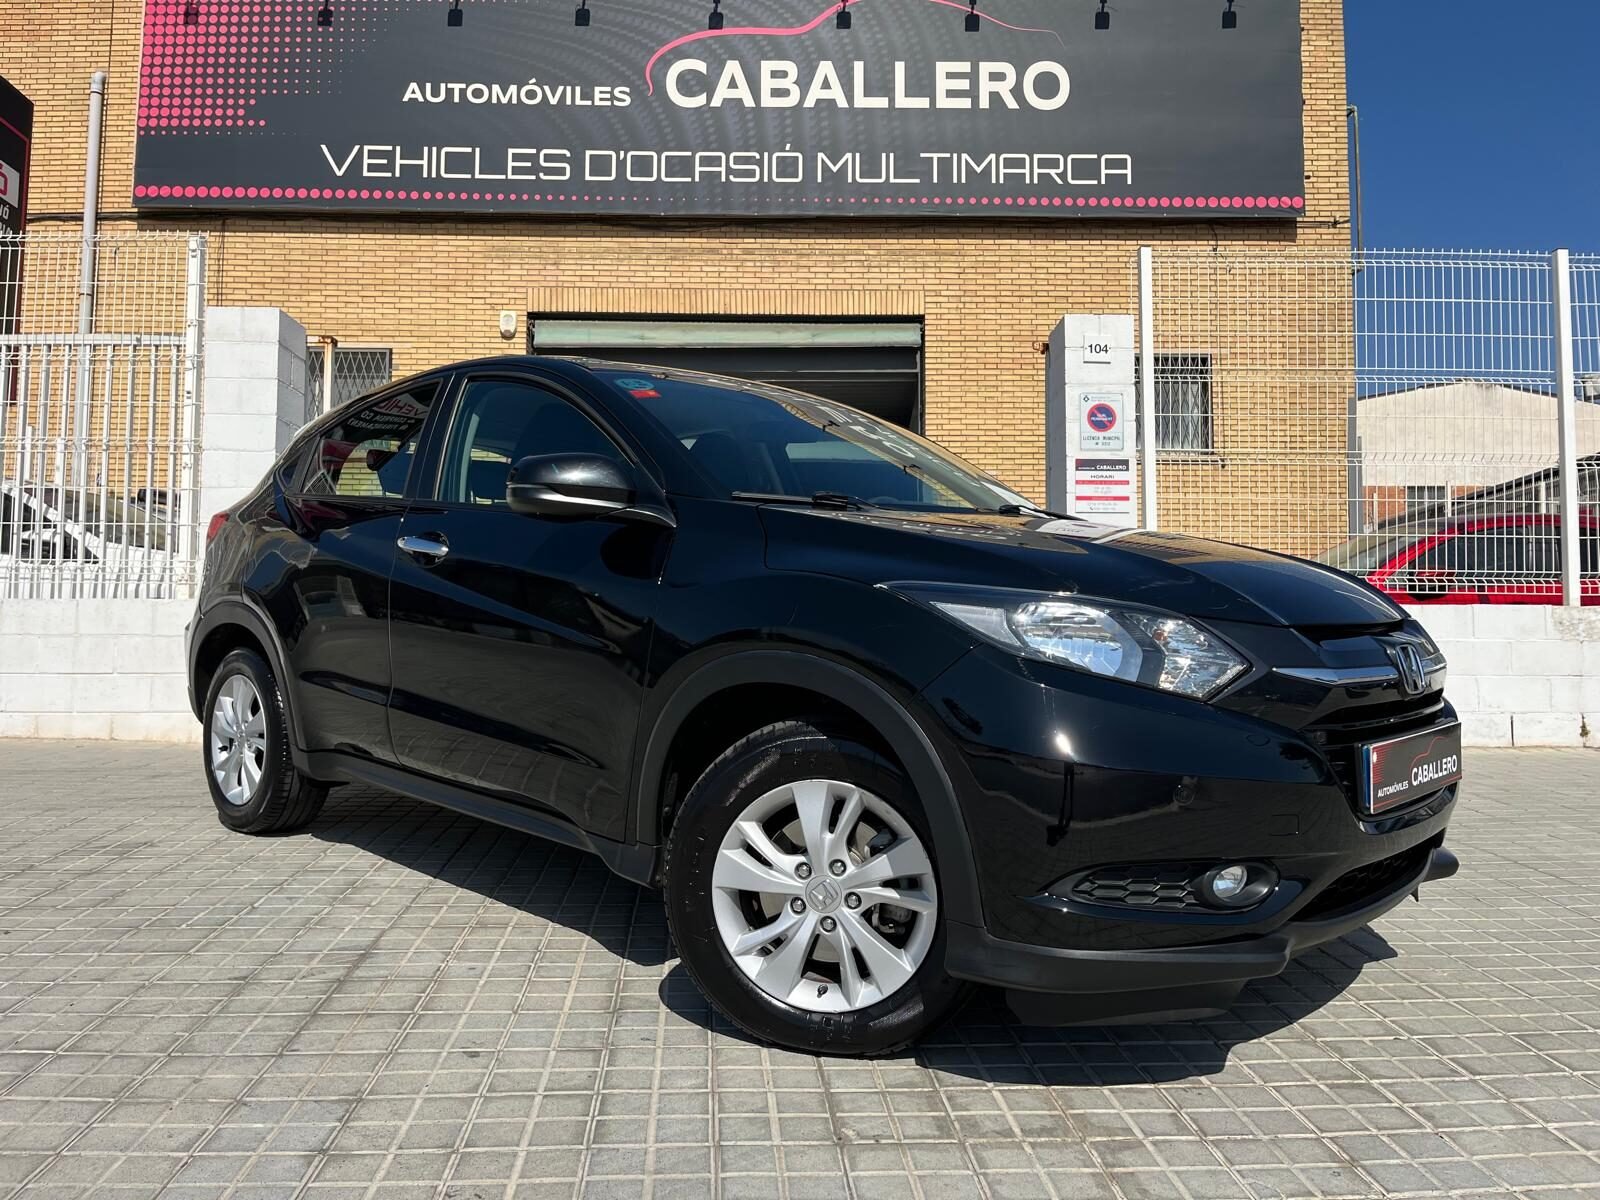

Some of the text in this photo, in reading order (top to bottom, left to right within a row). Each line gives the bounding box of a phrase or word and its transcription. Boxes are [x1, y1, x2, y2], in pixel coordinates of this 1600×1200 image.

[402, 58, 1071, 111] AUTOMÓVILES CABALLERO
[320, 143, 1132, 185] VEHICLES D'OCASIÓ MULTIMARCA
[1087, 343, 1109, 354] 104
[1377, 755, 1458, 798] AUTOMÓVILES CABALLERO
